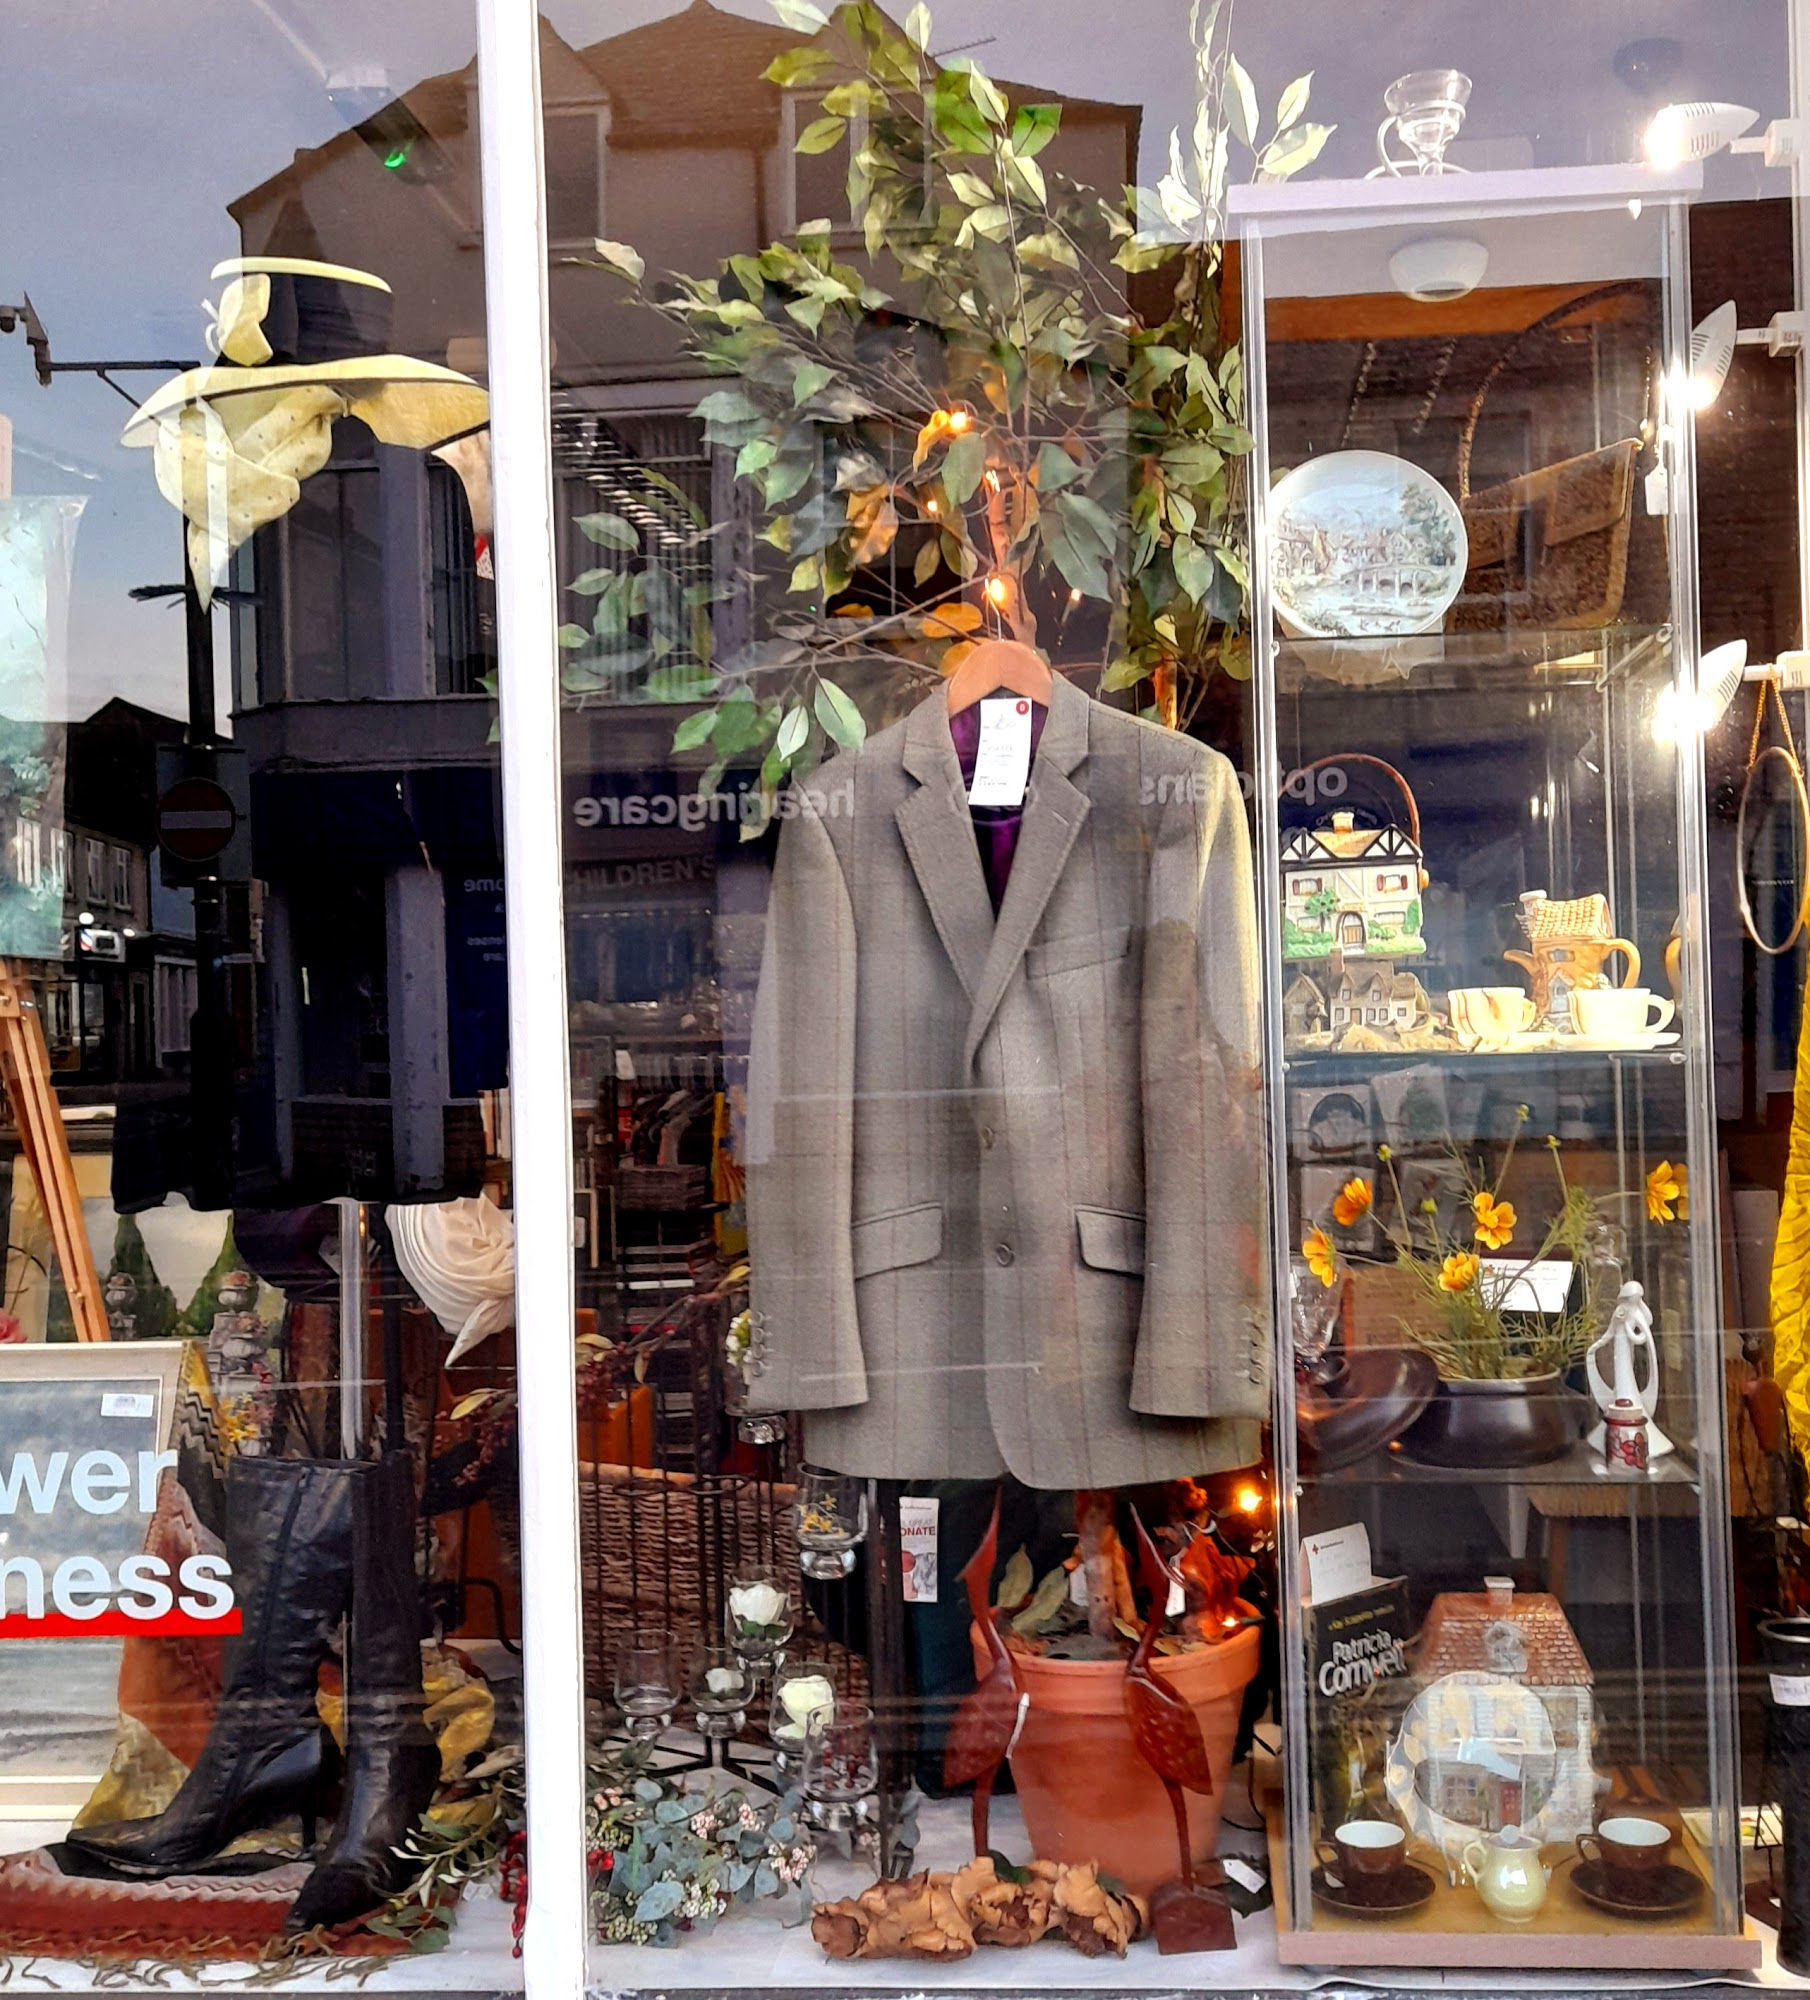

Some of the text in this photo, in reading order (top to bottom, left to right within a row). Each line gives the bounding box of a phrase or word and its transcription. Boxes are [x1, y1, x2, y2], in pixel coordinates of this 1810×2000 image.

[0, 1449, 178, 1515] wer
[0, 1554, 235, 1621] ness
[1332, 1628, 1392, 1665] Patricia
